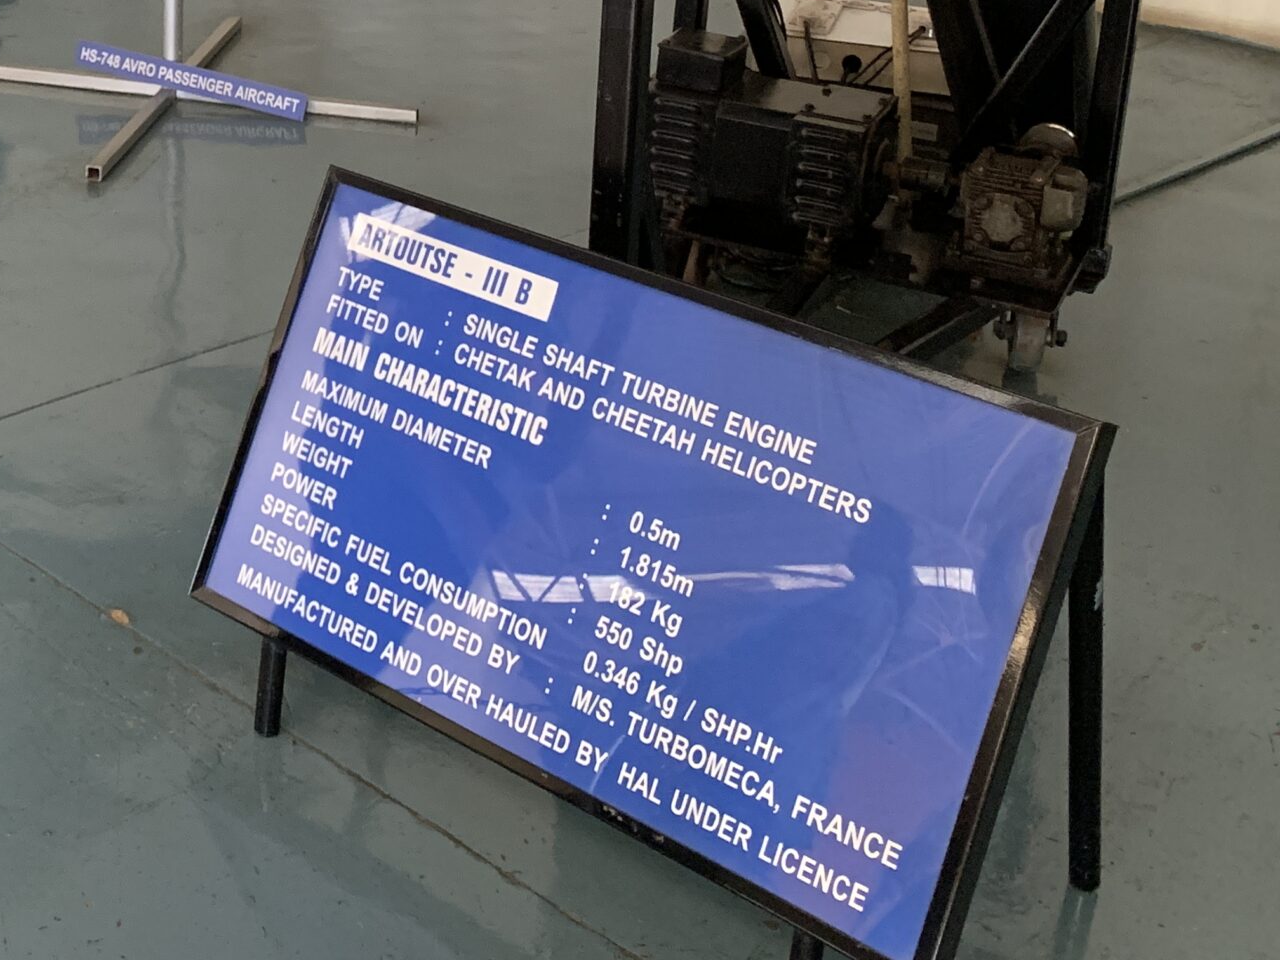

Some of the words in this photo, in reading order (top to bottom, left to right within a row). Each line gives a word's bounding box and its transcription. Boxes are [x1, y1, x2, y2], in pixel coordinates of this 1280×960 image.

[80, 47, 121, 69] HS-748
[122, 57, 156, 77] AVRO
[158, 65, 233, 97] PASSENGER
[234, 85, 300, 113] AIRCRAFT
[337, 265, 384, 301] TYPE
[463, 314, 539, 359] SINGLE
[542, 343, 616, 386] SHAFT
[621, 371, 719, 428] TURBINE
[723, 411, 817, 465] ENGINE
[357, 224, 458, 279] ARTOUTSE
[482, 266, 509, 297] III
[514, 278, 533, 305] B
[300, 369, 388, 424] MAXIMUM
[391, 408, 492, 469] DIAMETER
[629, 511, 681, 551] 0.5m
[312, 326, 370, 371] MAIN
[373, 352, 548, 446] CHARACTERISTIC
[325, 293, 389, 334] FITTED
[394, 321, 424, 349] ON
[454, 343, 537, 392] CHETAK
[537, 377, 585, 410] AND
[592, 397, 696, 455] CHEETAH
[700, 438, 872, 523] HELICOPTERS
[272, 462, 337, 510] POWER
[594, 615, 633, 650] 550
[639, 636, 683, 677] Shp
[281, 431, 352, 478] WEIGHT
[609, 581, 646, 616] 182
[650, 600, 683, 638] Kg
[290, 399, 364, 449] LENGTH
[621, 546, 694, 597] 1.815m
[250, 523, 341, 584] DESIGNED
[345, 572, 359, 596] &
[364, 582, 483, 657] DEVELOPED
[487, 643, 520, 674] BY
[571, 685, 615, 727] M/S.
[627, 711, 780, 814] TURBOMECA,
[791, 795, 903, 870] FRANCE
[260, 493, 341, 547] SPECIFIC
[344, 534, 392, 576] FUEL
[399, 562, 548, 650] CONSUMPTION
[583, 650, 641, 695] 0.346
[645, 680, 678, 719] Kg
[700, 707, 783, 764] SHP.Hr
[236, 563, 378, 652] MANUFACTURED
[380, 641, 422, 676] AND
[426, 664, 482, 709] OVER
[485, 694, 570, 754] HAULED
[575, 740, 609, 773] BY
[617, 762, 661, 805] HAL
[670, 789, 752, 851] UNDER
[758, 835, 870, 912] LICENCE
